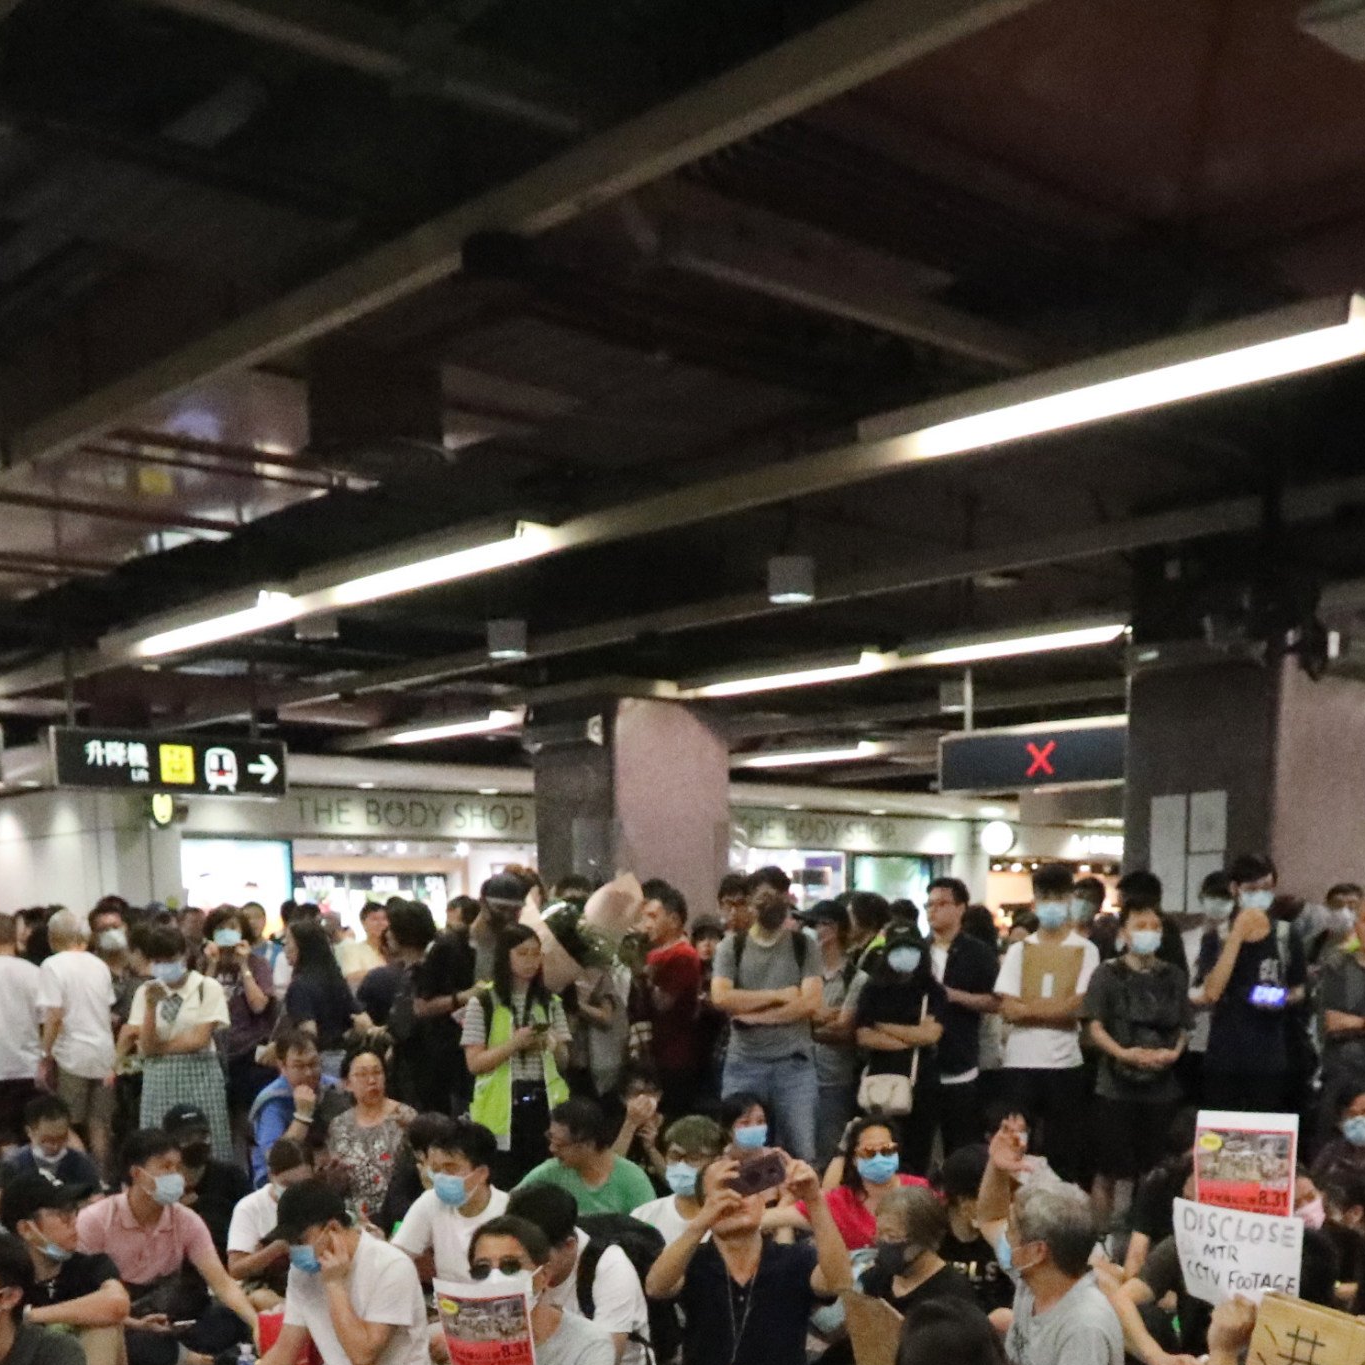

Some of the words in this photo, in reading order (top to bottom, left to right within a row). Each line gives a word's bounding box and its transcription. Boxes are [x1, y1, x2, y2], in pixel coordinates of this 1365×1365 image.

[85, 739, 149, 768] 升降機
[296, 798, 351, 826] THE
[366, 798, 442, 829] BODY
[453, 801, 525, 831] SHOP
[1183, 1206, 1296, 1248] DISCLOSE
[1203, 1243, 1239, 1263] MTR
[1186, 1259, 1221, 1286] CCTV
